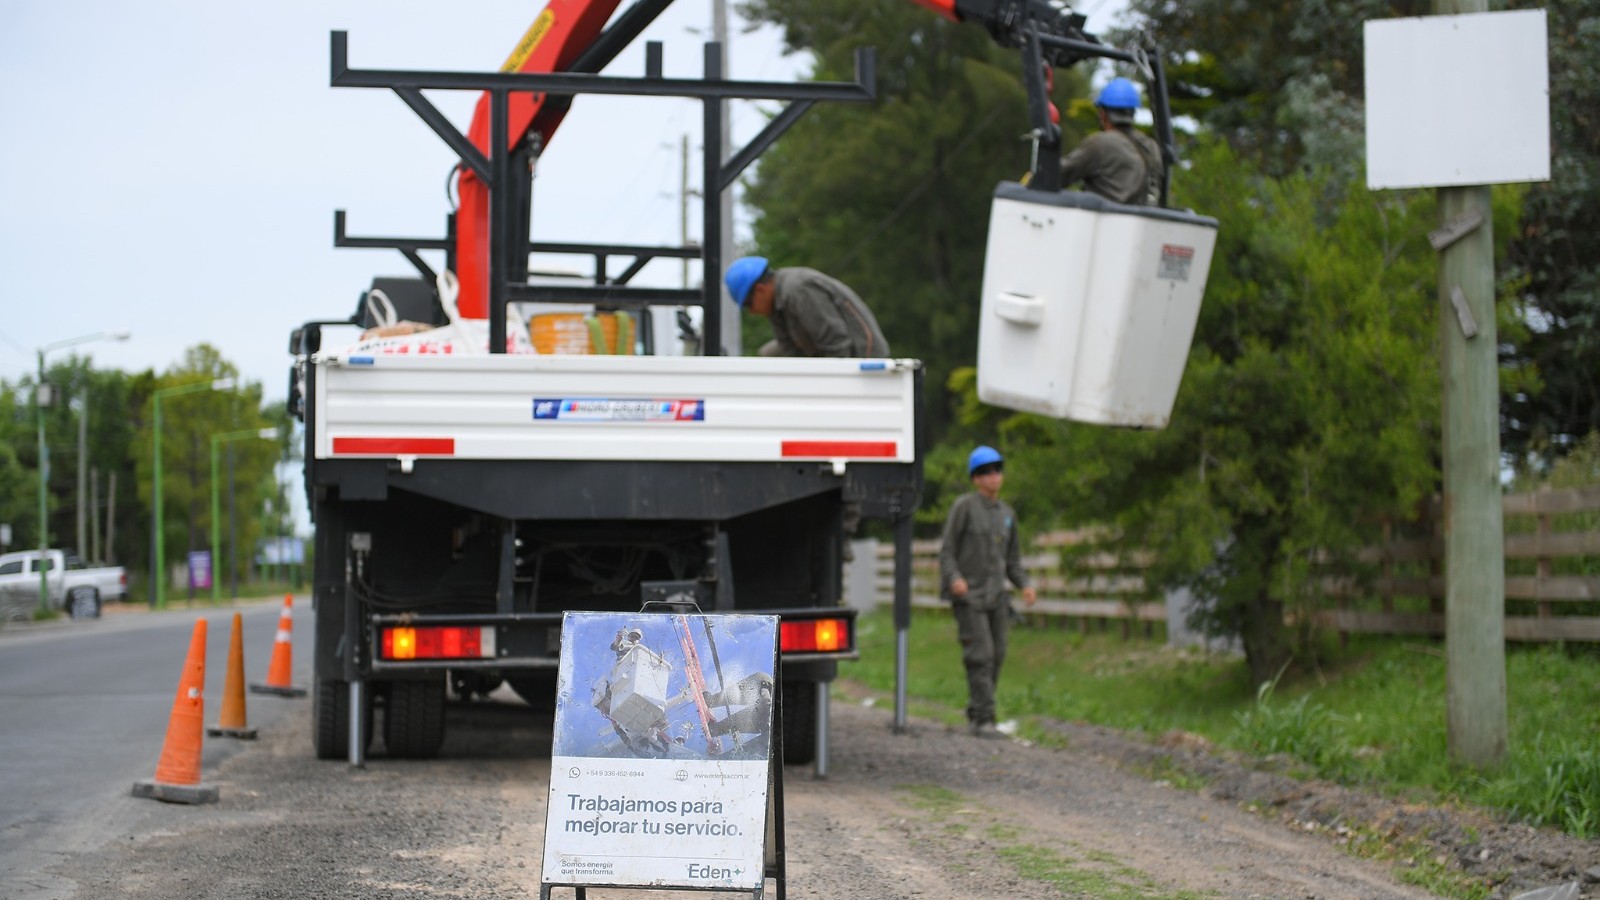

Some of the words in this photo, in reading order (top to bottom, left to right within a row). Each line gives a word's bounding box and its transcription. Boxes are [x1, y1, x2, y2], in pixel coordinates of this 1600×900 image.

[567, 794, 677, 815] Trabajamos
[681, 800, 723, 816] para
[565, 816, 638, 836] mejorar
[642, 819, 660, 834] tu
[664, 820, 743, 836] servicio.
[561, 860, 585, 868] Somos
[575, 868, 615, 876] transforma.
[688, 863, 731, 879] Eden
